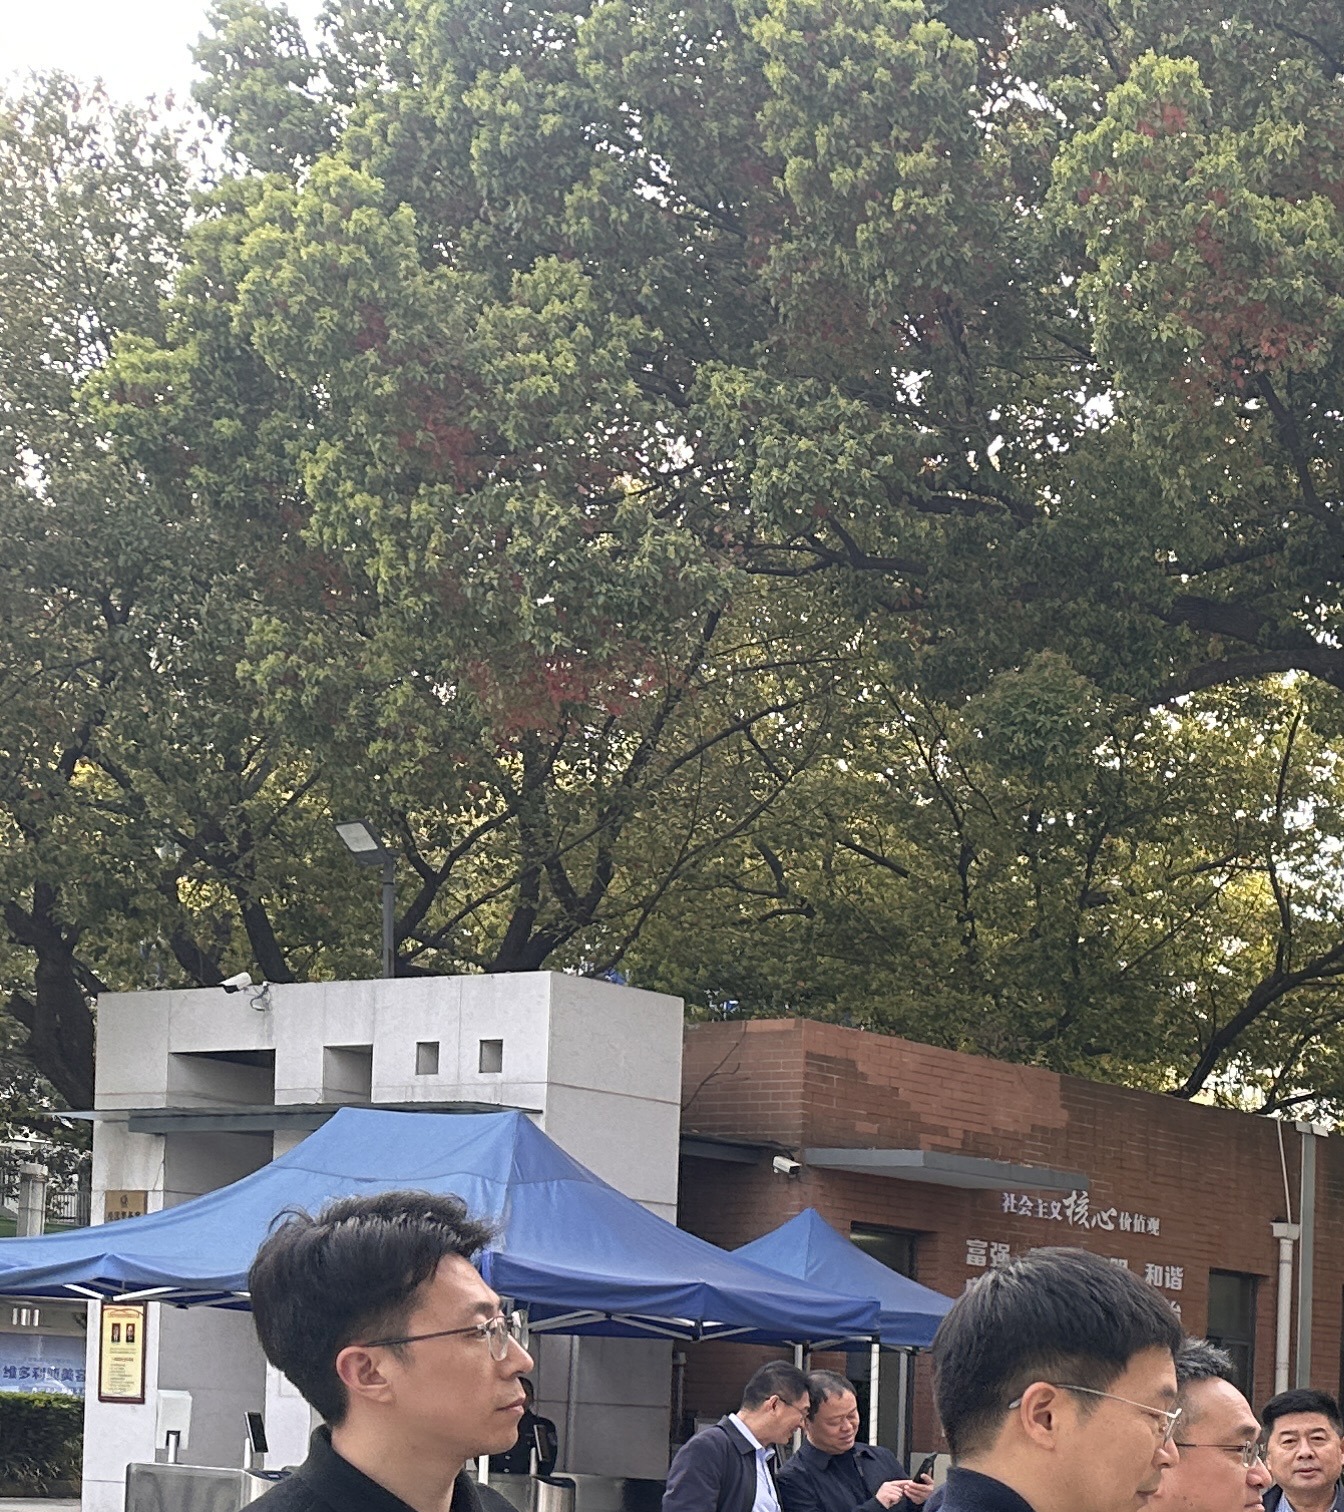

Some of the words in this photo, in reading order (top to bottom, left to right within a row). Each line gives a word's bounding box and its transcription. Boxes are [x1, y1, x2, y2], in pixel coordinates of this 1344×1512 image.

[1003, 1190, 1161, 1236] 社会主义核心价值观
[966, 1239, 1010, 1268] 富强
[1145, 1262, 1184, 1291] 和谐
